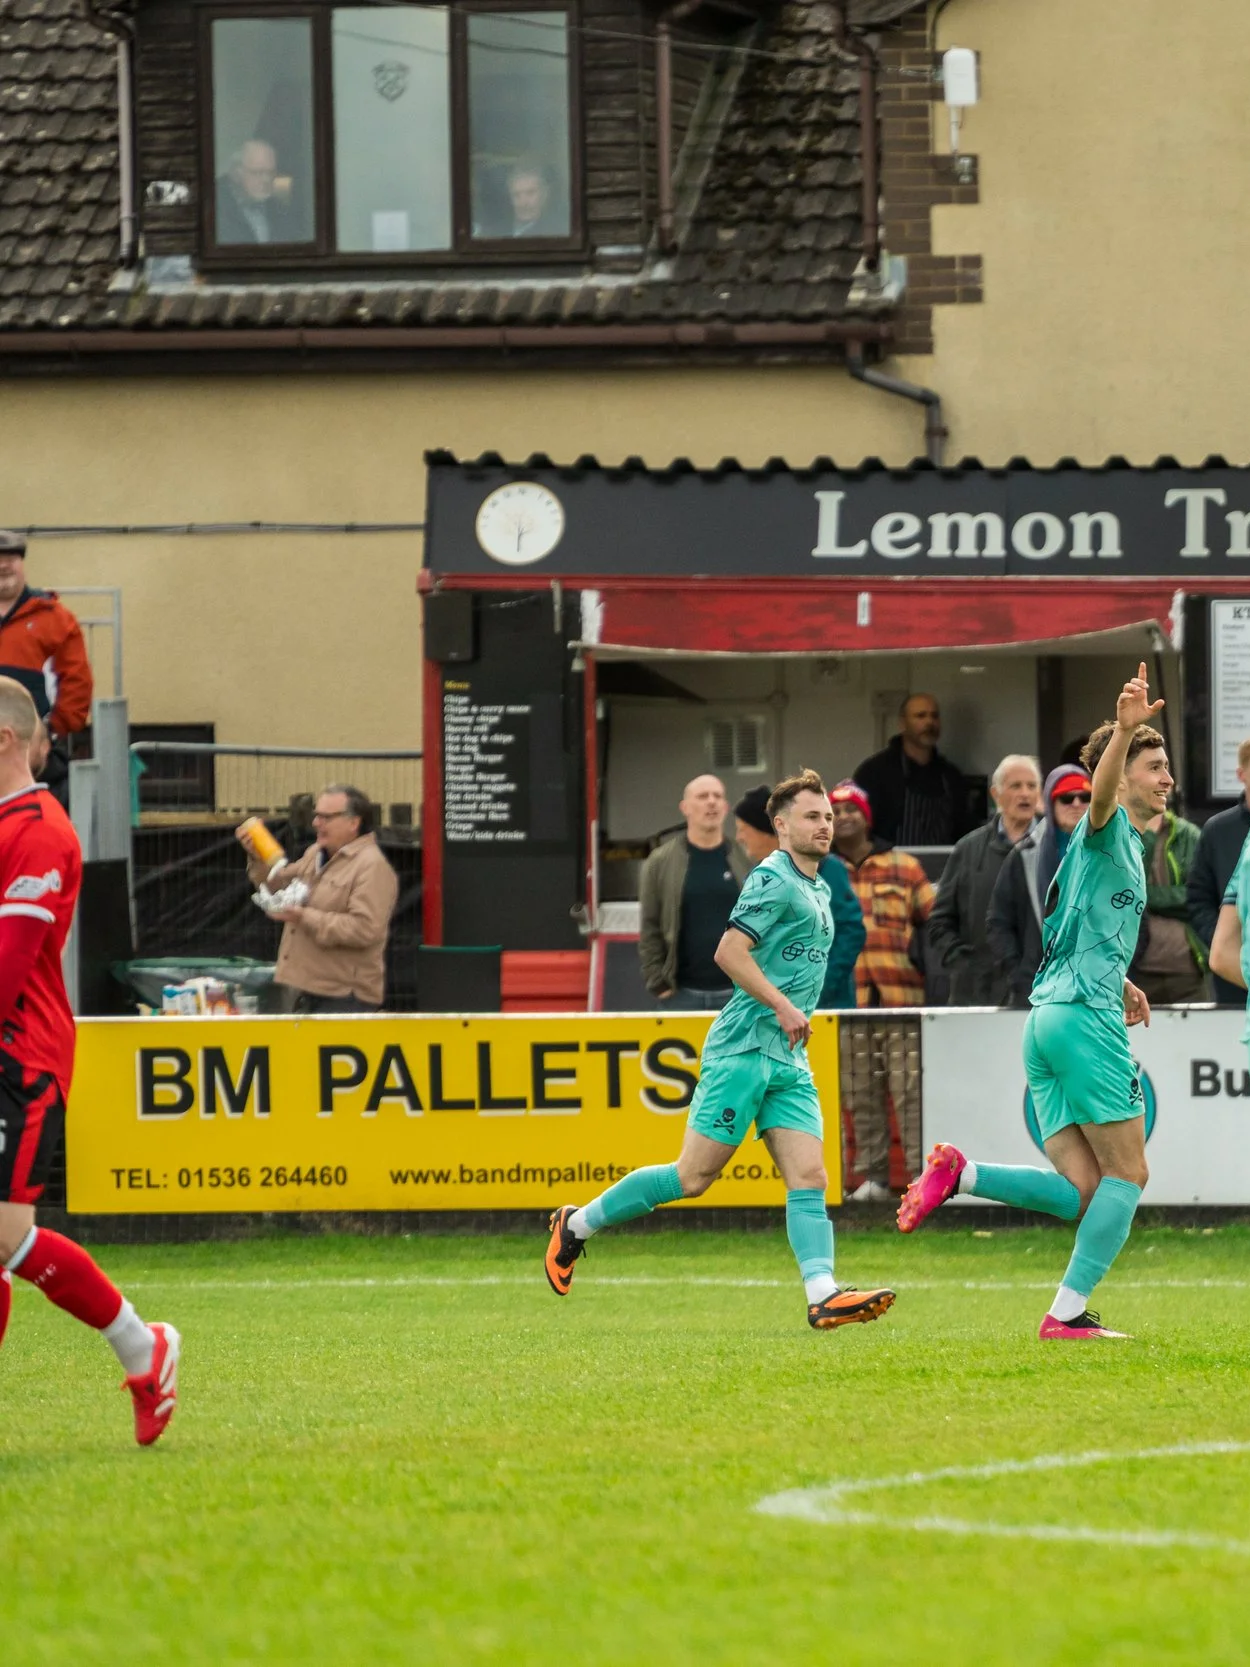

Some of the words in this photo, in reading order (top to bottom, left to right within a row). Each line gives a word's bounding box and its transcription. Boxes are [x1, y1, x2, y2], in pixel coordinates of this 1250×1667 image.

[811, 490, 1123, 559] Lemon
[136, 1046, 272, 1120] BM
[316, 1037, 700, 1118] PALLETS
[111, 1168, 168, 1190] TEL:
[178, 1167, 252, 1189] 01536
[260, 1166, 348, 1187] 264460
